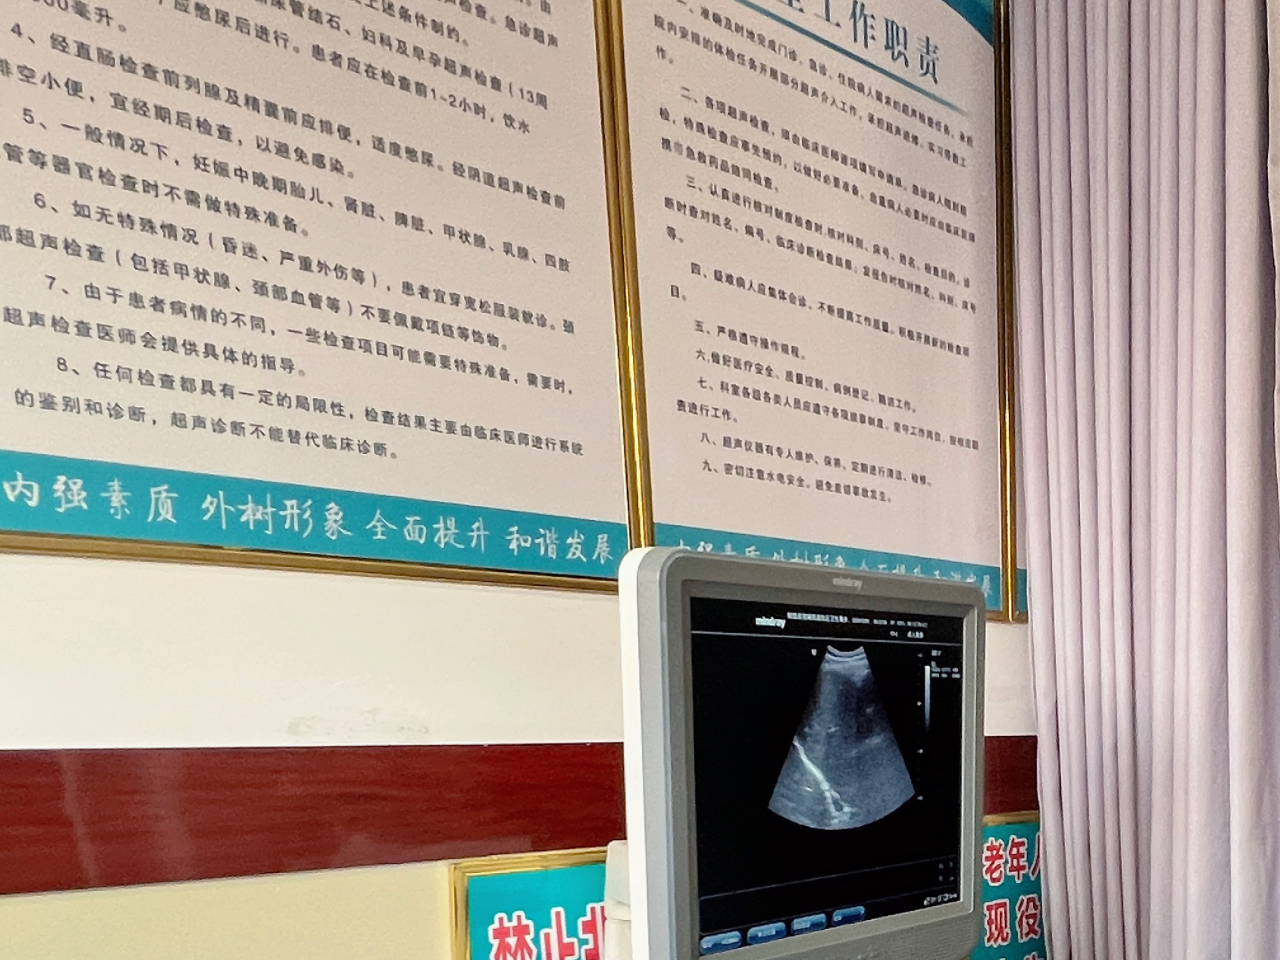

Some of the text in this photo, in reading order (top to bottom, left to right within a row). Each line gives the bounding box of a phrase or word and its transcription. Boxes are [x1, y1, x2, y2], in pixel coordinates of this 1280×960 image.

[787, 0, 938, 85] 工作职责
[2, 472, 615, 567] 内强素质 外树形象 全面提升 和谐发展
